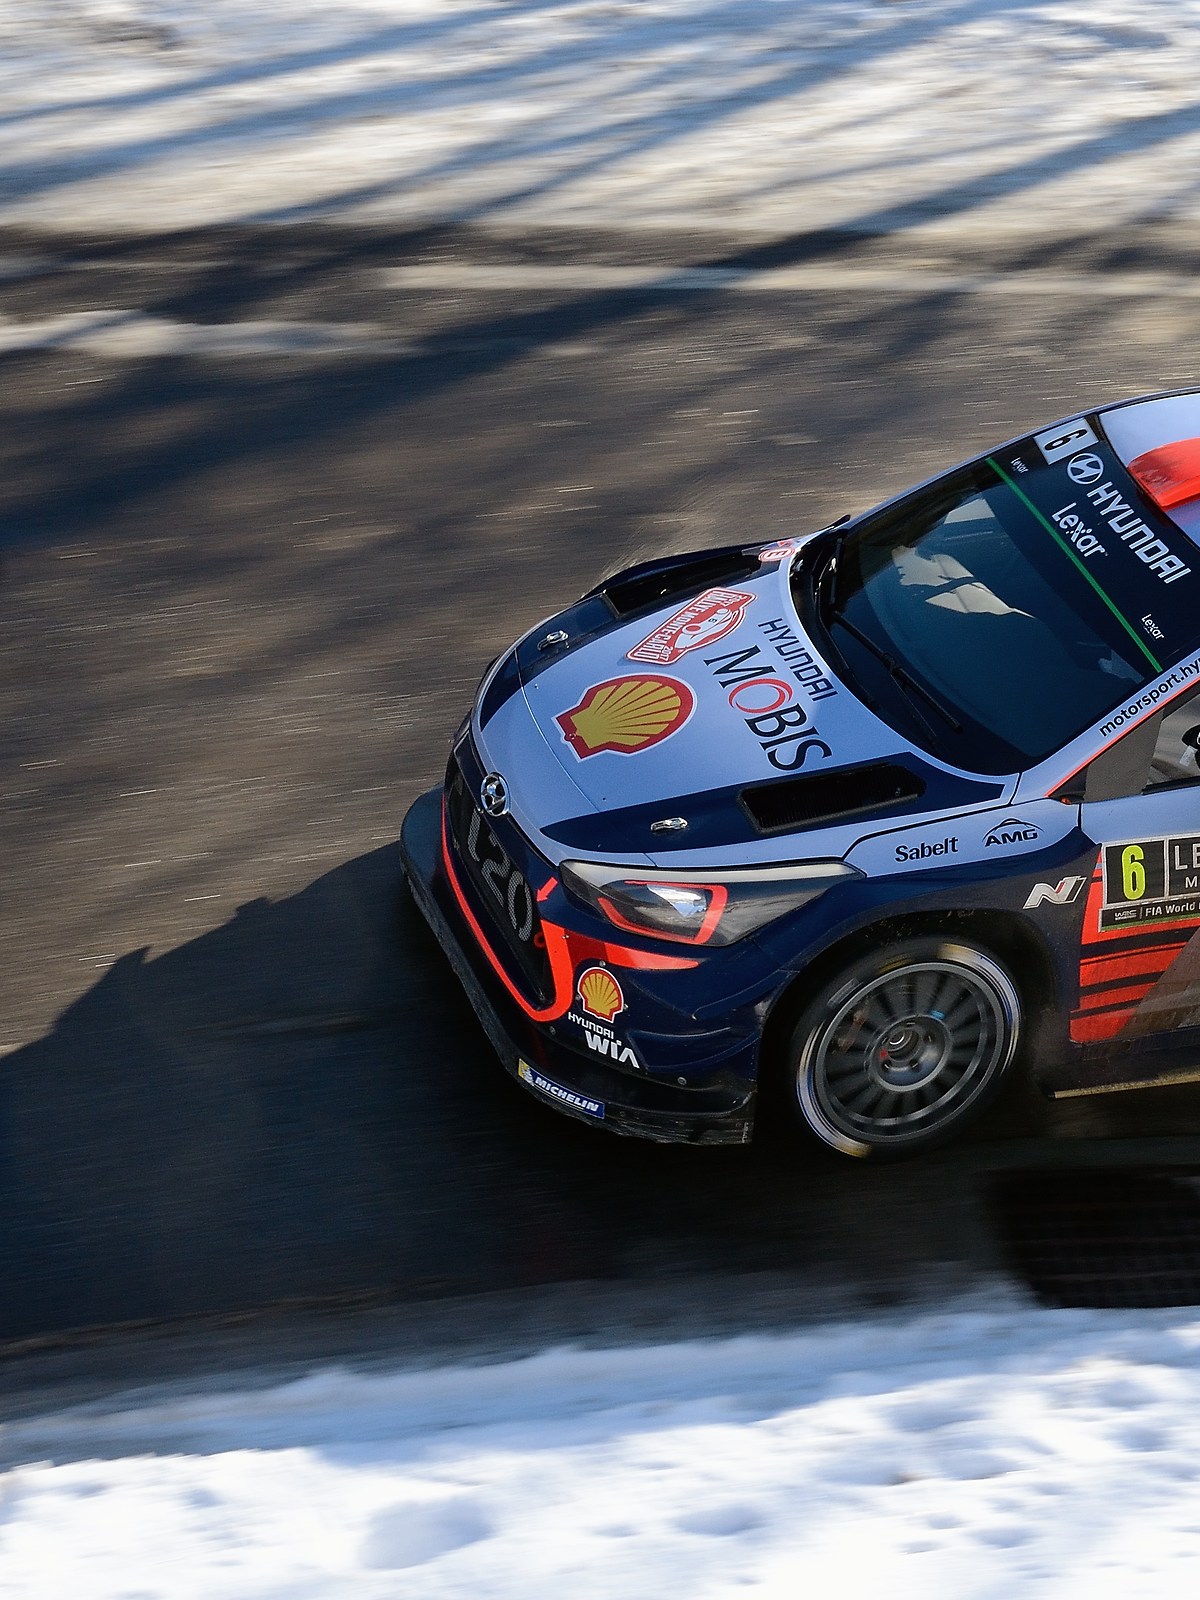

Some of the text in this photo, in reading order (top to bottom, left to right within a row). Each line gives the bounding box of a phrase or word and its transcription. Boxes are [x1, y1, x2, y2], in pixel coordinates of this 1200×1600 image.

[1051, 502, 1106, 558] Lexar
[1086, 481, 1192, 584] HYUNDAI
[689, 591, 732, 612] RALLYE
[1140, 613, 1165, 640] Lexar
[660, 646, 673, 661] 2017
[757, 618, 839, 702] HYUNDAI
[703, 644, 833, 771] MOBIS
[895, 836, 959, 862] Sabelt
[984, 828, 1039, 848] AMG
[1121, 844, 1146, 900] 6
[1145, 905, 1163, 917] FIA
[1165, 901, 1196, 915] World
[567, 1012, 615, 1040] HYUNDAI
[534, 1077, 600, 1112] MICHELIN
